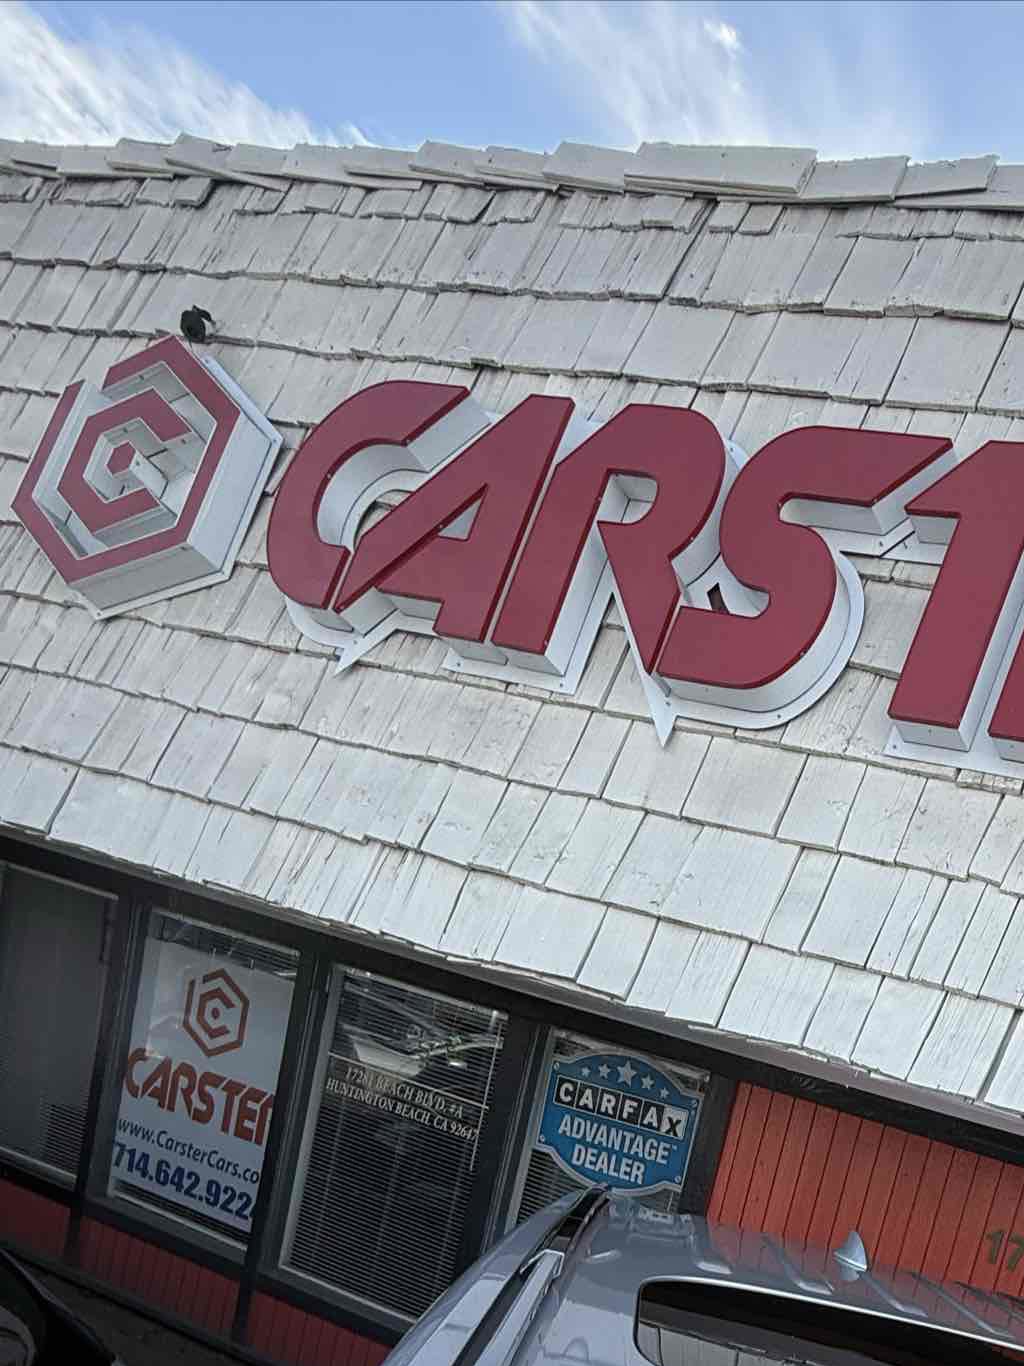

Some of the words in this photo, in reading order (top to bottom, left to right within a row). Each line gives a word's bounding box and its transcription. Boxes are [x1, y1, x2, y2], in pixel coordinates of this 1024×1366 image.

[326, 1077, 394, 1112] HUNTINGTON
[433, 1114, 448, 1131] CA
[376, 1074, 416, 1100] BEACH
[557, 1080, 684, 1138] CARFAX
[113, 1140, 256, 1220] 714.642.922
[572, 1143, 646, 1185] DEALER
